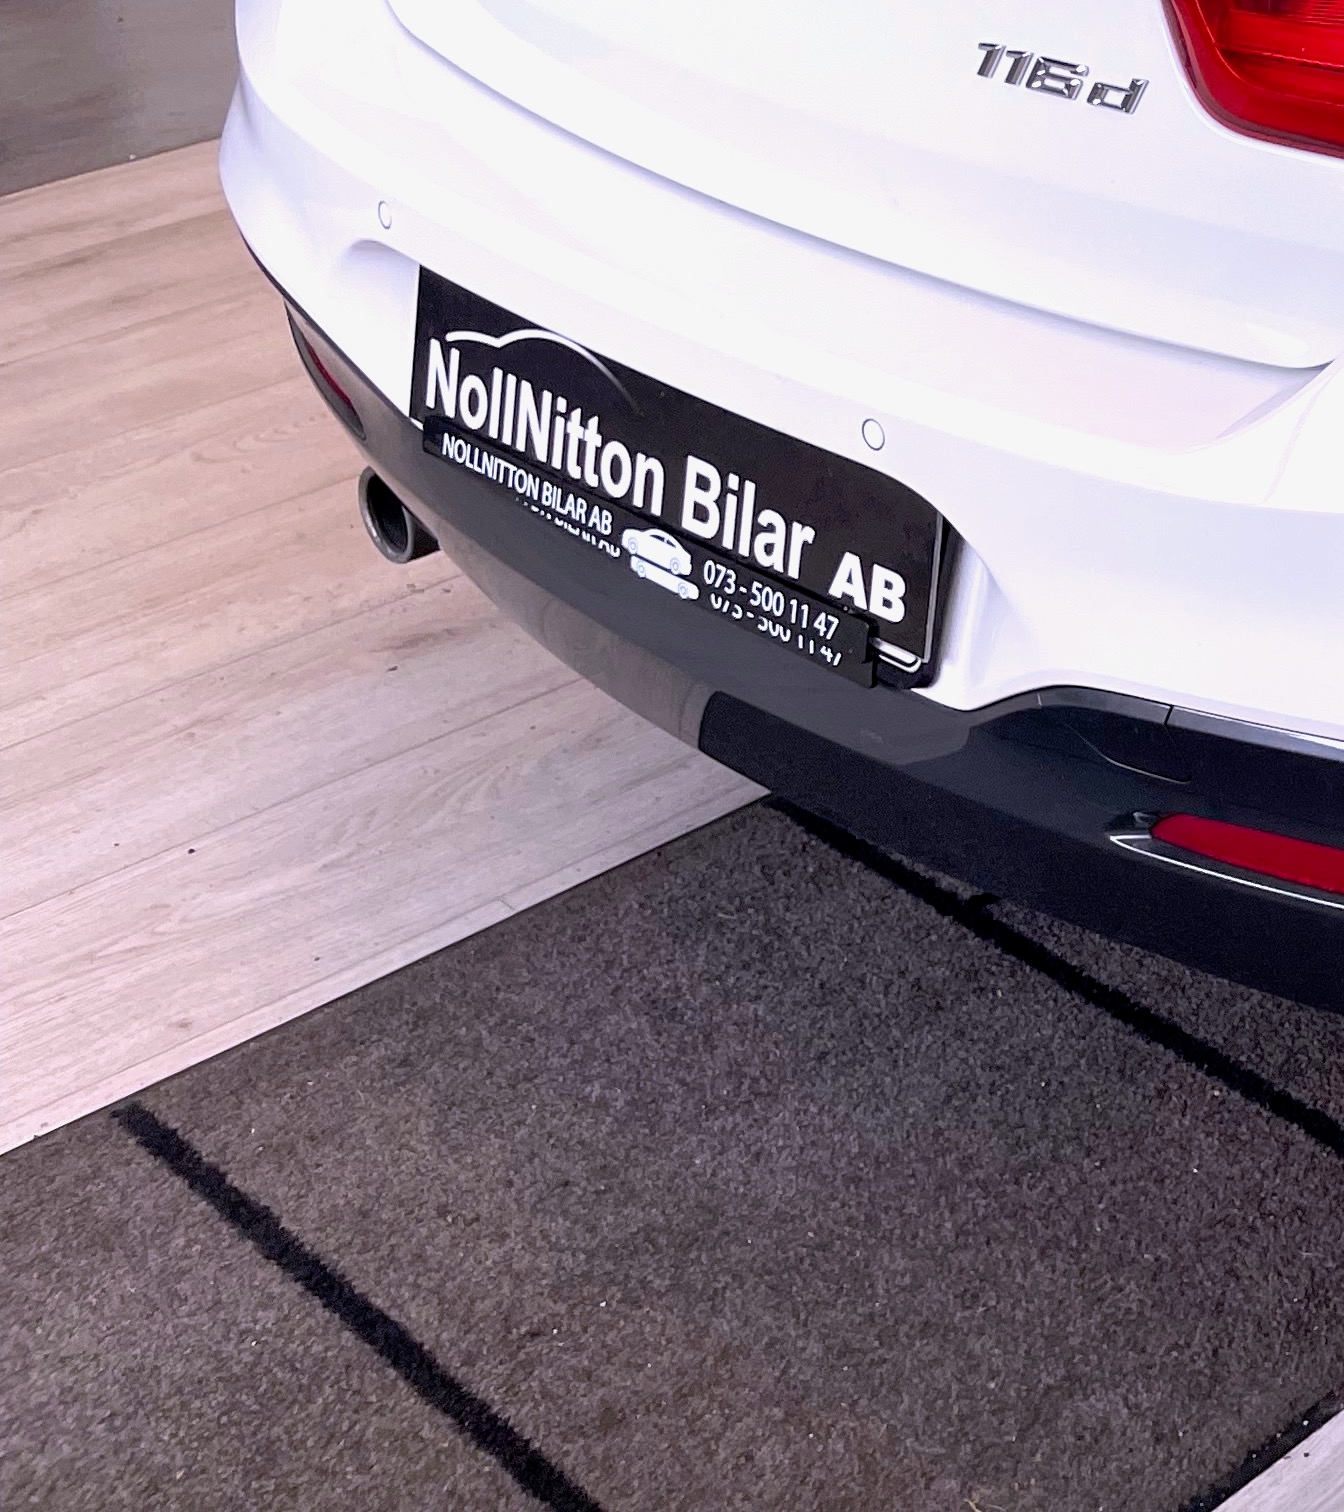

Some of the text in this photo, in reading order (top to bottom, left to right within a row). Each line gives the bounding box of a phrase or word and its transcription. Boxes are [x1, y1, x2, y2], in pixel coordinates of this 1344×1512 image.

[976, 41, 1150, 115] 116d
[424, 338, 665, 517] NollNitton
[680, 455, 816, 580] Bilar
[828, 552, 907, 623] AB
[442, 432, 540, 501] NOLLNITTON
[541, 481, 588, 524] BILAR
[588, 505, 613, 536] AB
[703, 559, 737, 595] 073
[750, 580, 785, 617] 500
[789, 598, 809, 629] 11
[813, 611, 840, 640] 47
